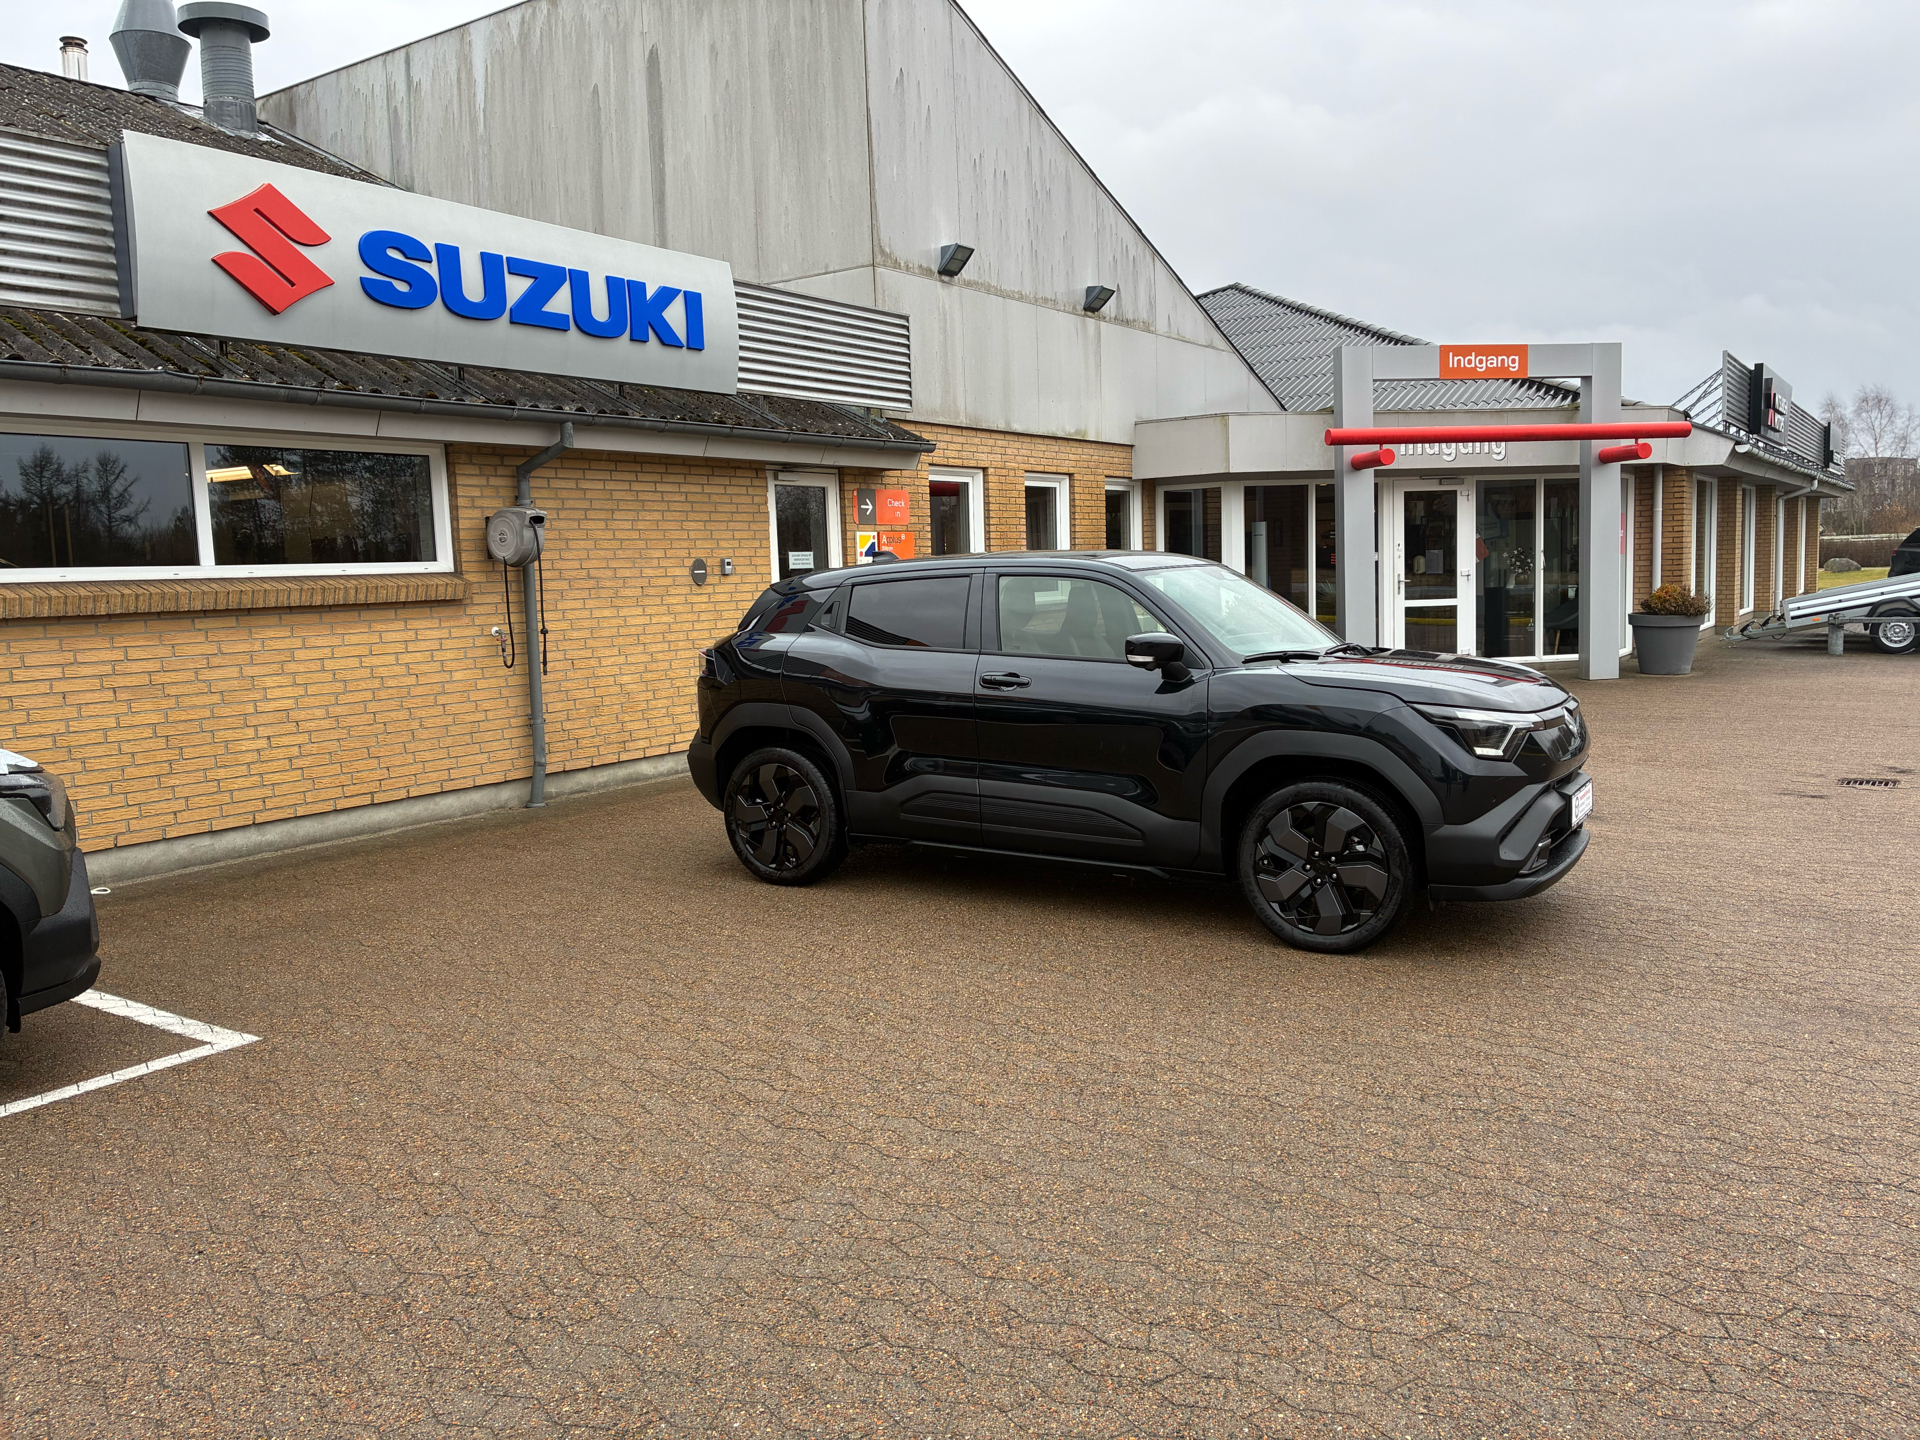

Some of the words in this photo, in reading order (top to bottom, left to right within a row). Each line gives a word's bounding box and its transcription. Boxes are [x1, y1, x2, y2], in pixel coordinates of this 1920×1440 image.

[358, 230, 705, 351] SUZUKI
[1449, 352, 1519, 372] Indgang
[887, 499, 905, 508] Check
[881, 534, 902, 546] Applus
